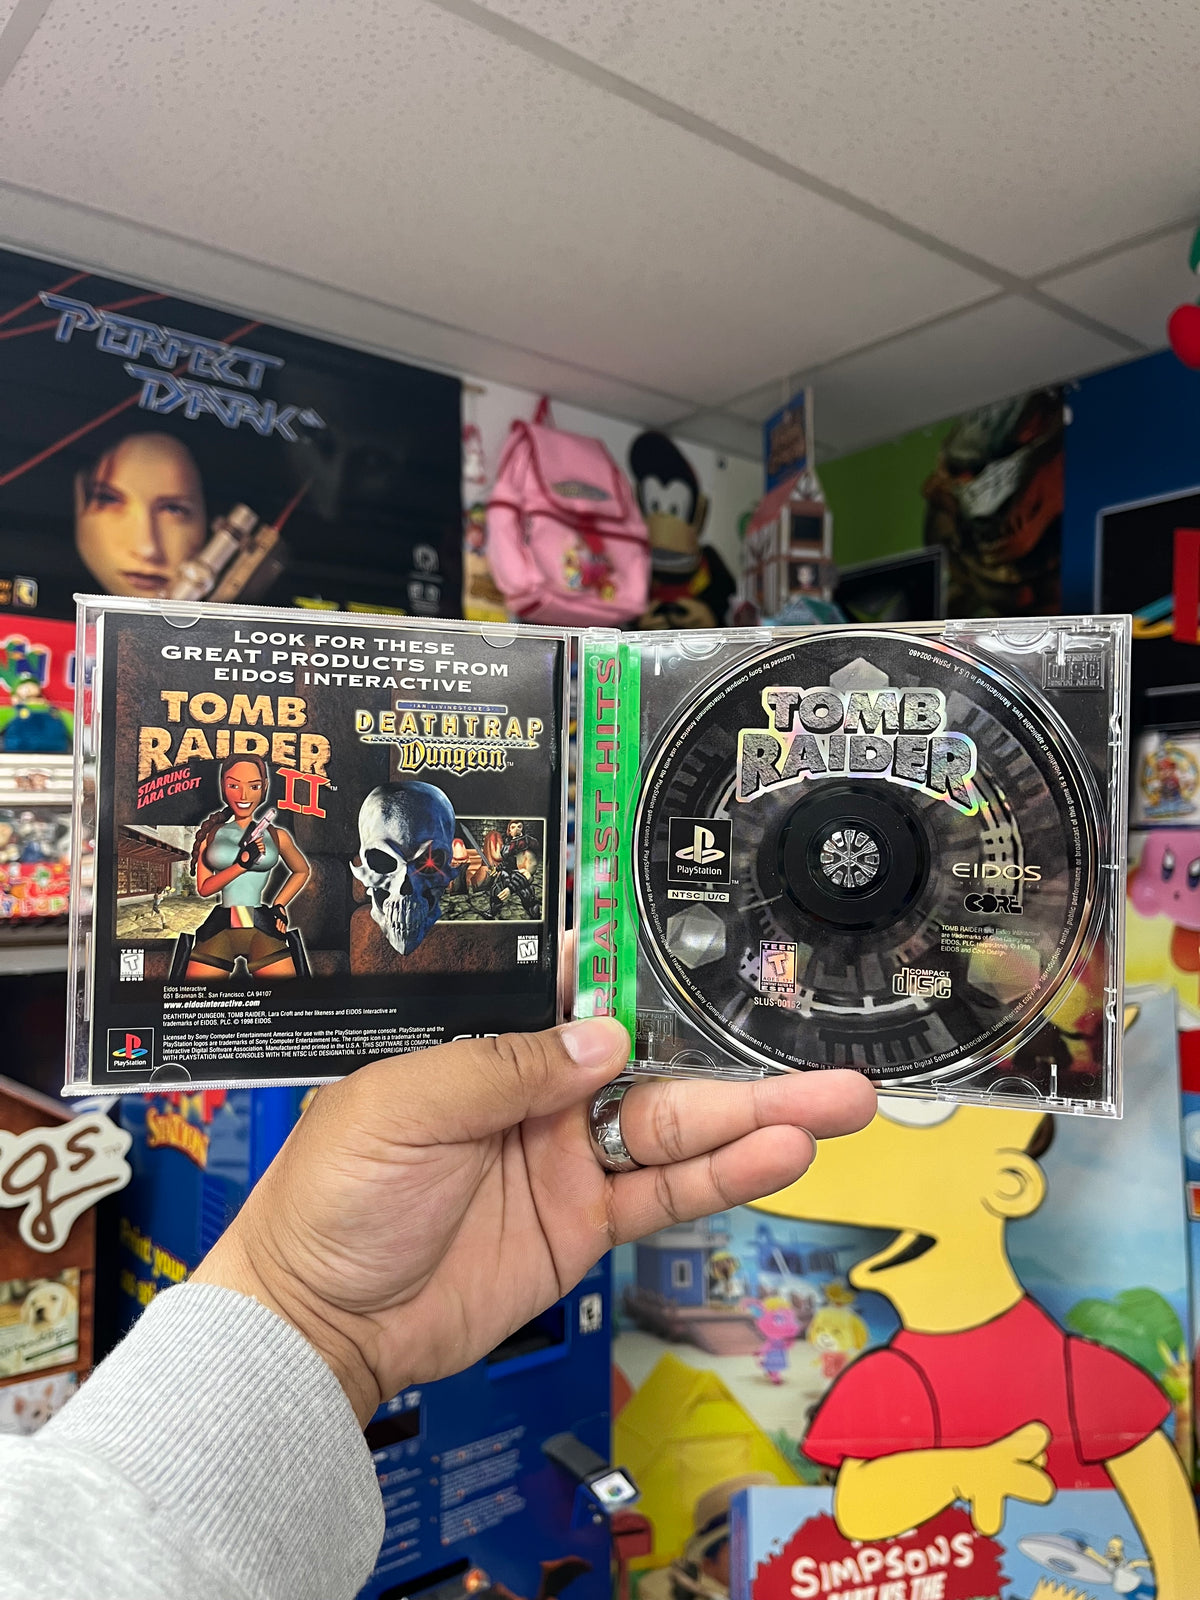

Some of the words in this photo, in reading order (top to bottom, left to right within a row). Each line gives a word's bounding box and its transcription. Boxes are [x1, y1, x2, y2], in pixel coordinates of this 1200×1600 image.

[38, 290, 286, 390] PERFECT
[123, 362, 300, 442] DARK
[234, 630, 306, 647] LOOK
[314, 634, 366, 650] FOR
[373, 638, 455, 656] THESE
[160, 645, 262, 663] GREAT
[271, 650, 425, 673] PRODUCTS
[435, 660, 509, 677] FROM
[747, 665, 763, 678] Sony
[769, 653, 795, 667] Licensed
[214, 667, 295, 684] EIDOS
[304, 672, 472, 693] INTERACTIVE
[723, 673, 749, 694] Computer
[975, 677, 1011, 707] Manufactured
[160, 690, 308, 728] TOMB
[595, 657, 622, 773] HITS
[694, 691, 725, 722] Entertainment
[765, 690, 944, 735] TOMB
[355, 709, 544, 740] DEATHTRAP
[679, 719, 697, 740] America
[1021, 717, 1045, 745] applicable
[137, 726, 332, 784] RAIDER
[400, 738, 507, 775] Dungeon
[662, 757, 673, 769] with
[1045, 750, 1062, 775] violation
[137, 767, 190, 798] STARRING
[740, 732, 973, 810] RAIDER
[136, 789, 164, 810] LARA
[166, 777, 202, 797] CROFT
[276, 767, 331, 819] II
[647, 778, 663, 809] PlayStation
[1064, 787, 1074, 804] game
[644, 809, 652, 824] game
[1068, 805, 1076, 817] this
[1072, 826, 1081, 856] broadcast
[642, 849, 650, 880] PlayStation
[676, 864, 722, 877] PlayStation
[952, 862, 1042, 882] EIDOS
[671, 890, 701, 900] NTSC
[707, 892, 727, 901] U/C
[1070, 866, 1082, 905] performance
[592, 790, 620, 1017] REATEST
[963, 892, 1024, 915] CORE
[648, 902, 663, 933] PlayStation
[1065, 906, 1076, 925] public
[519, 940, 537, 959] M
[762, 943, 795, 951] TEEN
[123, 954, 139, 971] T
[671, 957, 692, 985] trademarks
[767, 953, 786, 975] T
[909, 968, 950, 977] COMPACT
[761, 985, 794, 993] ESRB
[892, 966, 952, 999] disc
[163, 1000, 261, 1009] www.eidosinteractive.com
[693, 989, 707, 1004] Sony
[753, 996, 801, 1009] SLUS-00152
[704, 1001, 728, 1024] Computer
[991, 1002, 1023, 1032] Unauthorized
[236, 1031, 272, 1039] Entertainment
[398, 1026, 426, 1034] PlayStation
[410, 1038, 443, 1046] COMPATIBLE
[727, 1020, 763, 1047] Entertainment
[762, 1043, 773, 1052] Inc.
[784, 1053, 805, 1065] ratings
[933, 1047, 959, 1062] Software
[113, 1059, 147, 1068] PlayStation
[806, 1060, 819, 1068] icon
[882, 1063, 913, 1072] Interactive
[913, 1057, 933, 1069] Digital
[0, 1127, 120, 1244] gs
[790, 1532, 974, 1599] SIMPSONS
